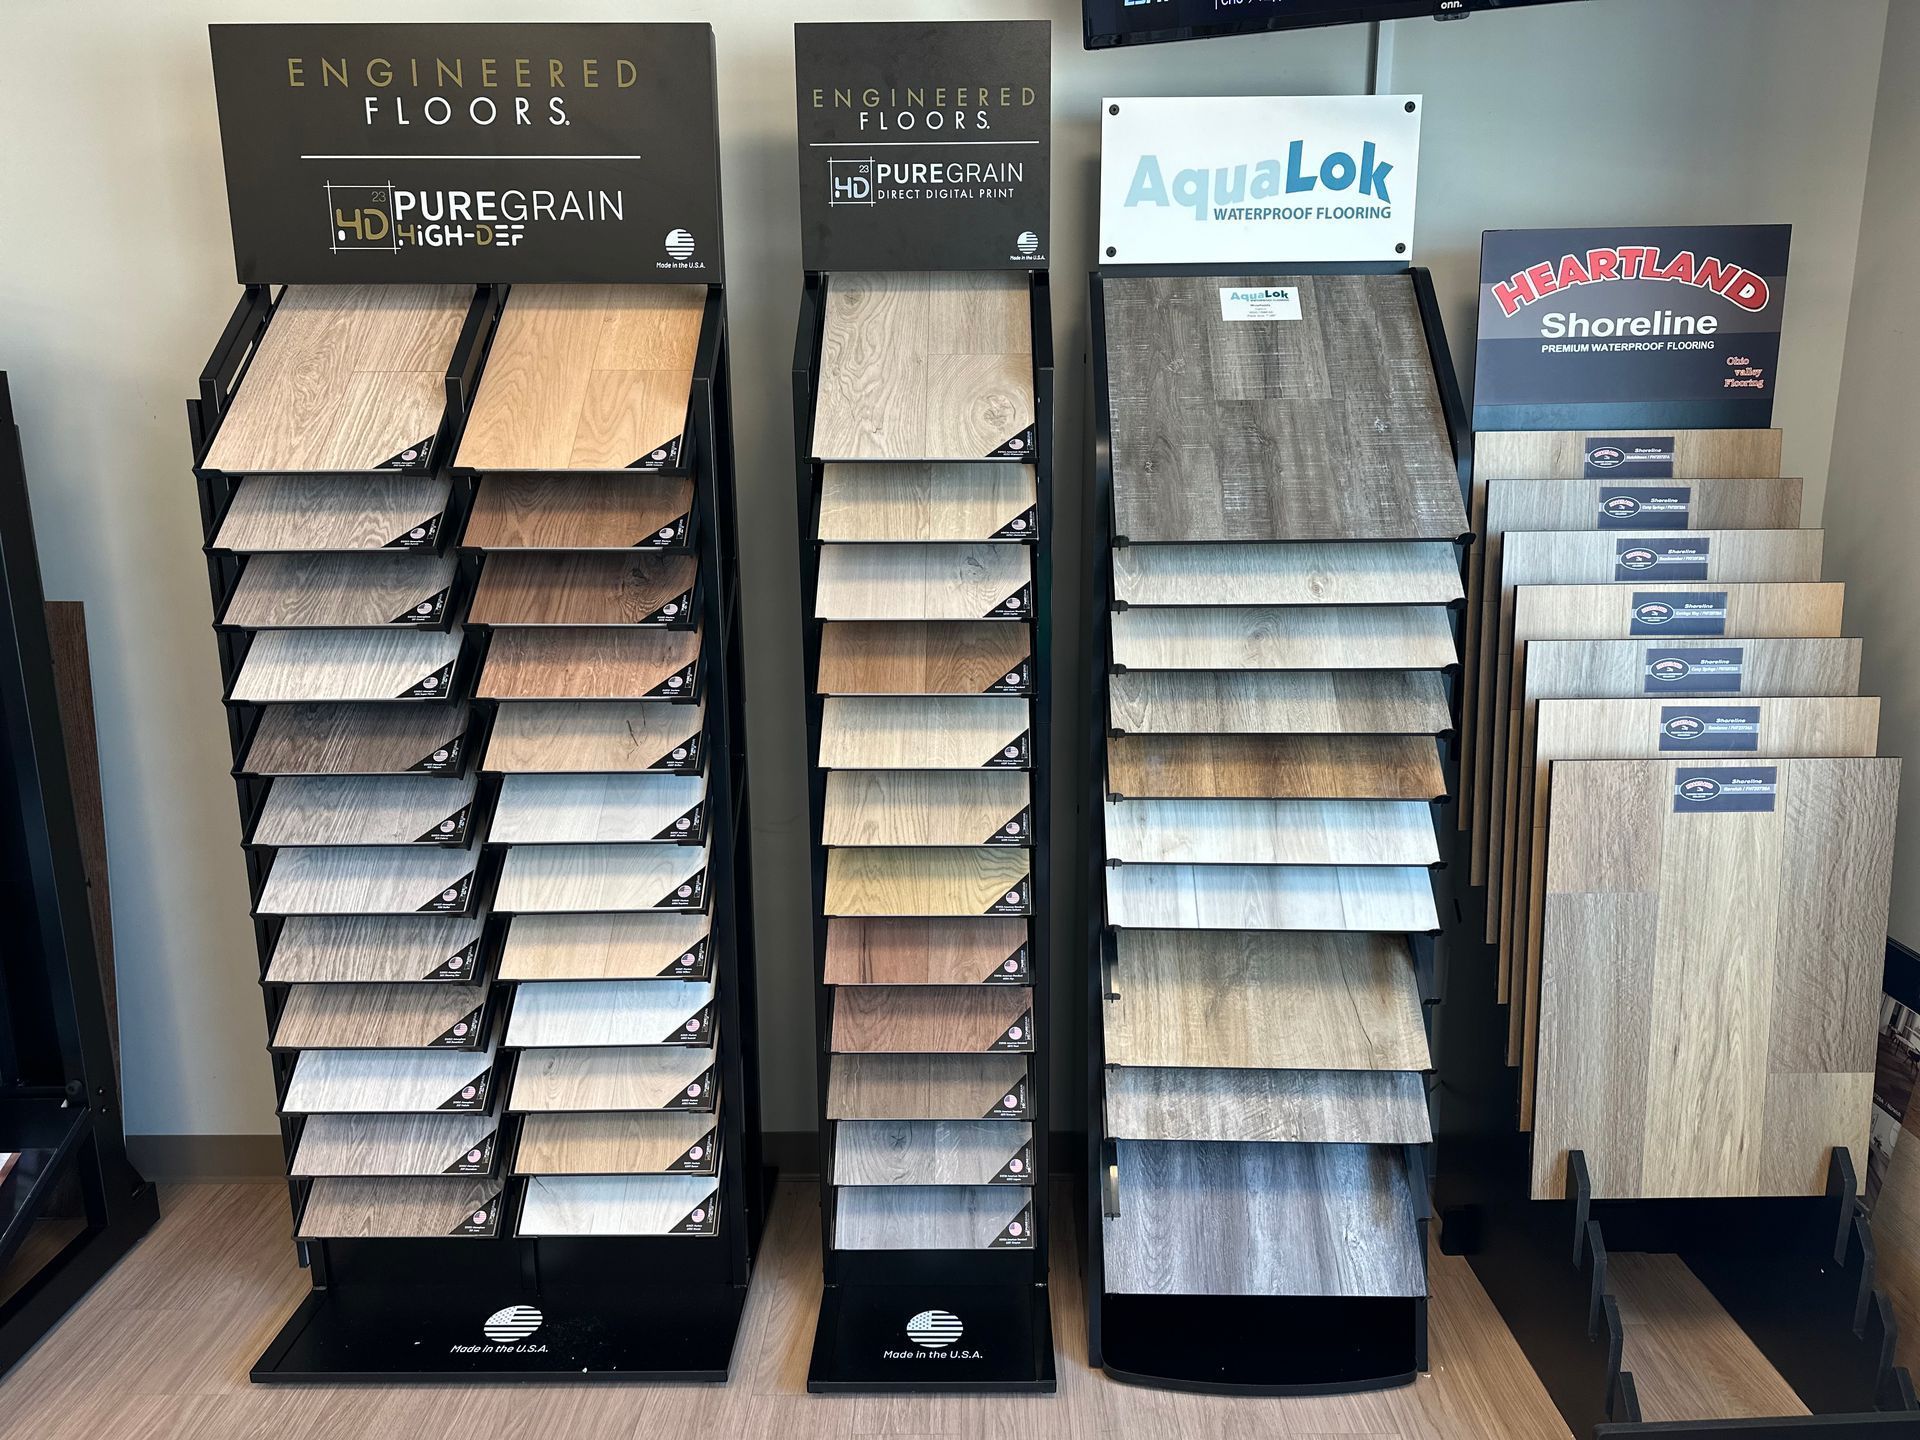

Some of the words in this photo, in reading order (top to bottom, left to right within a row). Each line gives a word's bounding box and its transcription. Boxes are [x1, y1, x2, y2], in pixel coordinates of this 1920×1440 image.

[1440, 1, 1462, 9] onn.
[288, 57, 638, 88] ENGINEERED
[813, 88, 1035, 108] ENGINEERED
[859, 164, 870, 173] 23
[877, 163, 1024, 184] PUREGRAIN
[1124, 140, 1394, 221] AquaLok
[371, 191, 387, 203] 23
[878, 190, 920, 200] DIRECT
[926, 189, 974, 199] DIGITAL
[979, 189, 1014, 199] PRINT
[395, 190, 623, 221] PUREGRAIN
[1213, 207, 1313, 220] WATERPROOF
[1316, 206, 1392, 219] FLOORING
[1492, 246, 1769, 317] HEARTLAND
[1230, 290, 1289, 302] AquaLok
[1540, 310, 1718, 339] Shoreline
[1541, 343, 1589, 353] PREMIUM
[1592, 341, 1664, 352] WATERPROOF
[1667, 341, 1714, 350] FLOORING
[1726, 356, 1750, 366] Ohio
[1723, 378, 1764, 389] Flooring
[450, 1345, 481, 1353] Made
[482, 1345, 494, 1353] in
[495, 1345, 514, 1353] the
[516, 1344, 549, 1353] U.S.A.
[883, 1350, 914, 1359] Made
[916, 1350, 926, 1359] in
[928, 1350, 947, 1359] the
[950, 1350, 983, 1359] U.S.A.
